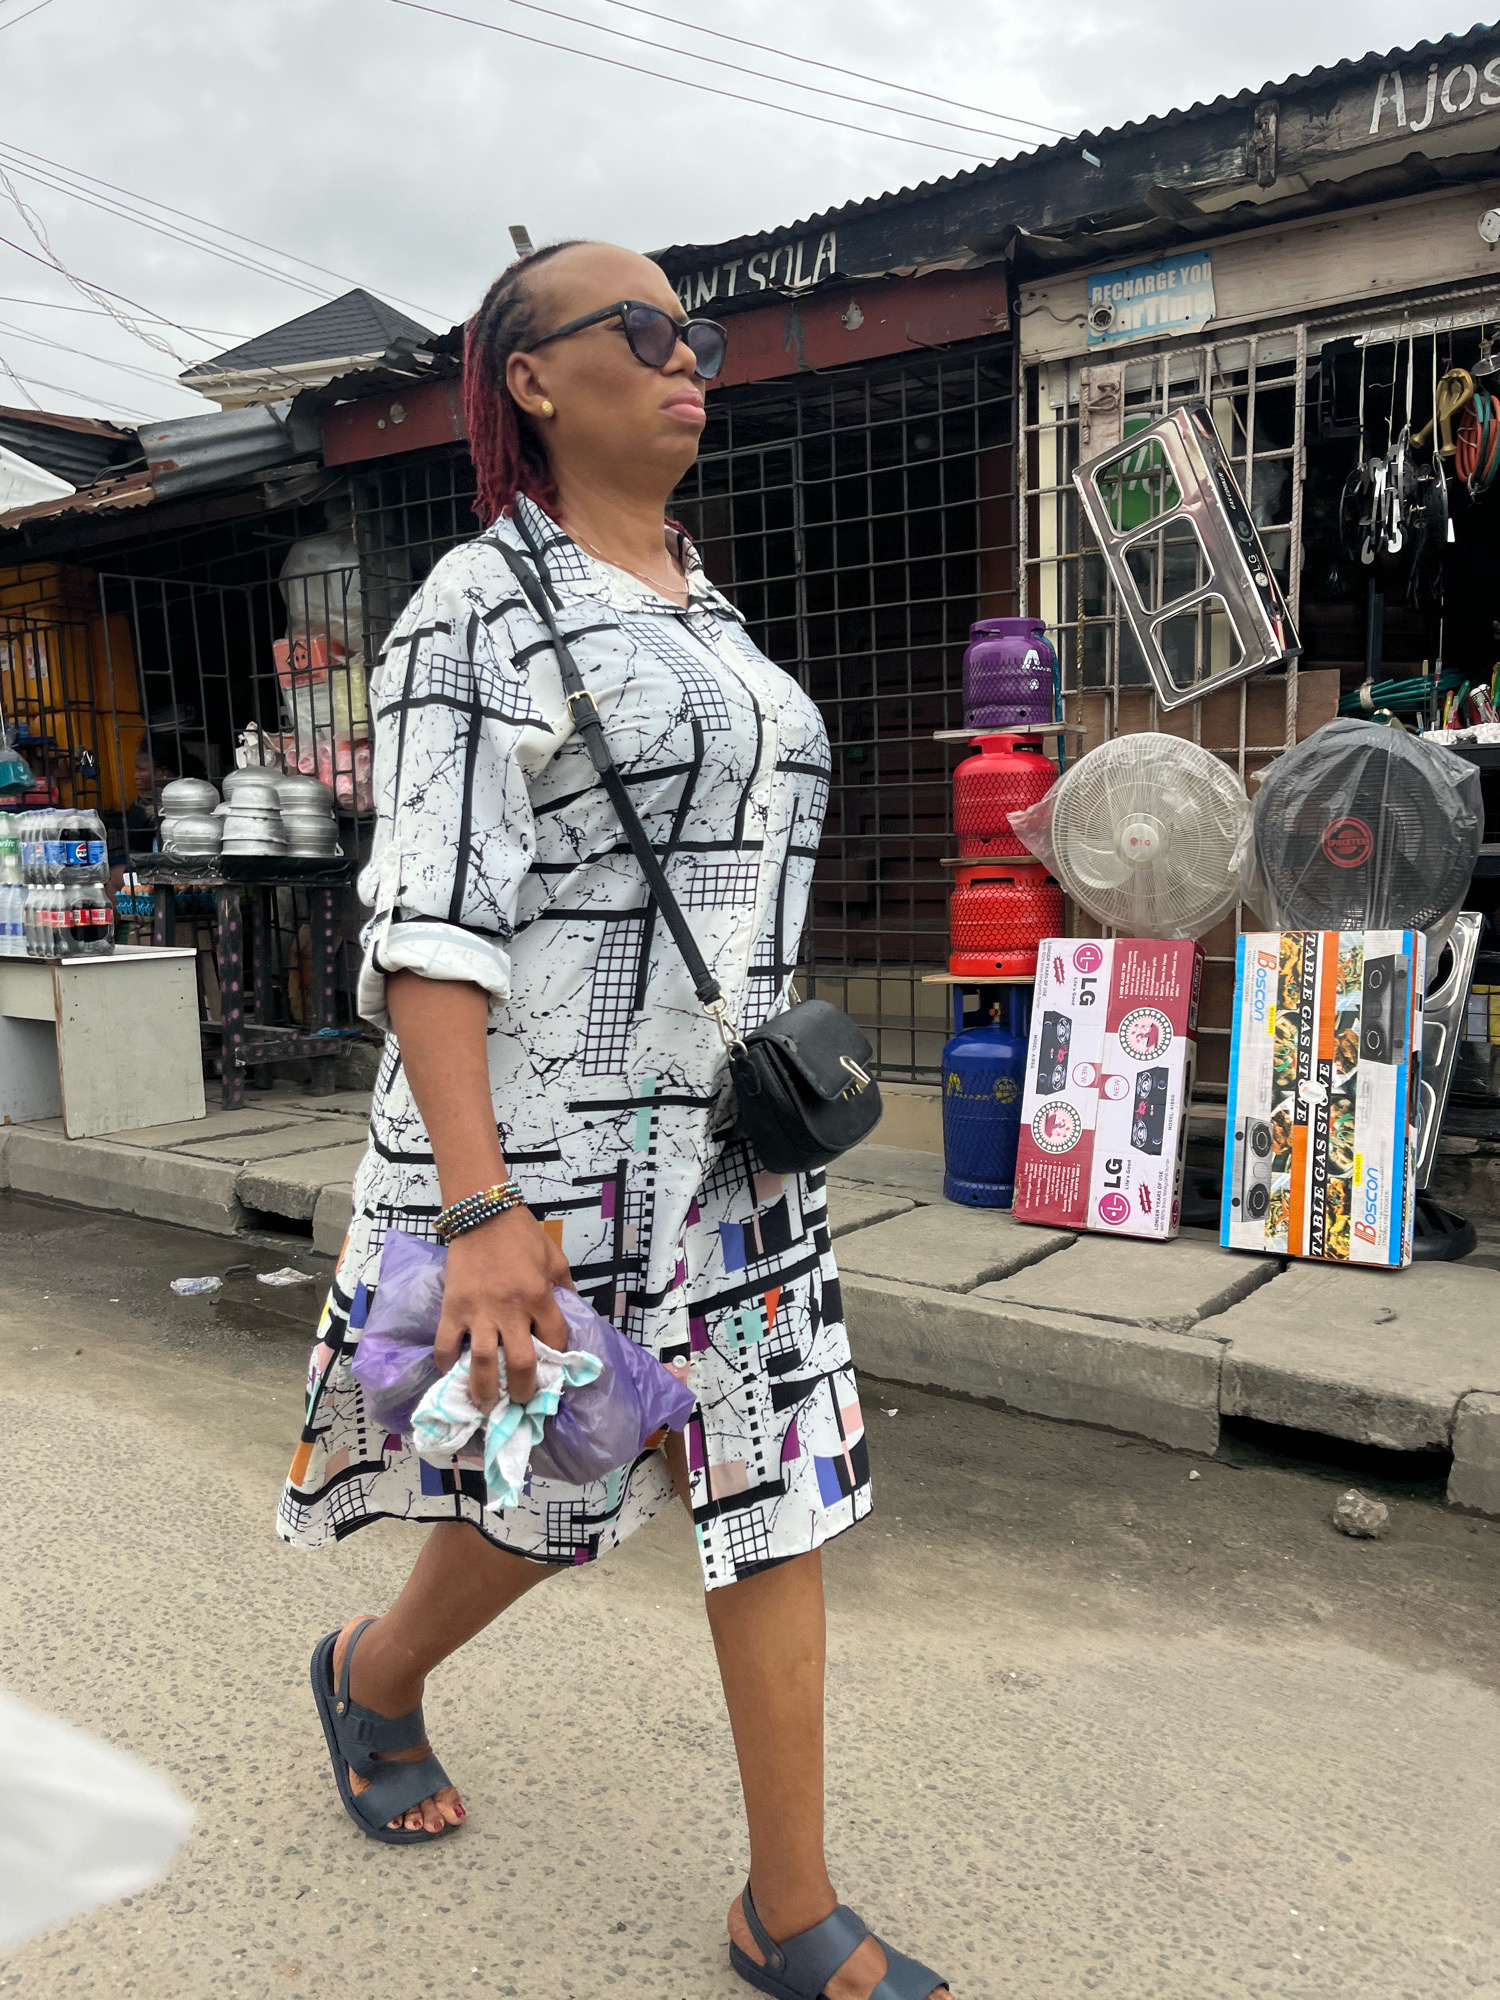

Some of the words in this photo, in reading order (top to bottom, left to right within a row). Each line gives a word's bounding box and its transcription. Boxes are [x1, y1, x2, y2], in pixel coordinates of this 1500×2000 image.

[1092, 270, 1176, 304] RECHARGE
[1248, 554, 1261, 573] LG
[1254, 950, 1277, 1021] Boscon
[1302, 934, 1317, 1001] TABLE
[1079, 977, 1098, 1006] LG
[1300, 1006, 1312, 1047] GAS
[1104, 1158, 1123, 1189] LG
[1314, 1139, 1326, 1181] GAS
[1312, 1186, 1325, 1255] TABLE
[1354, 1167, 1379, 1245] Boscon
